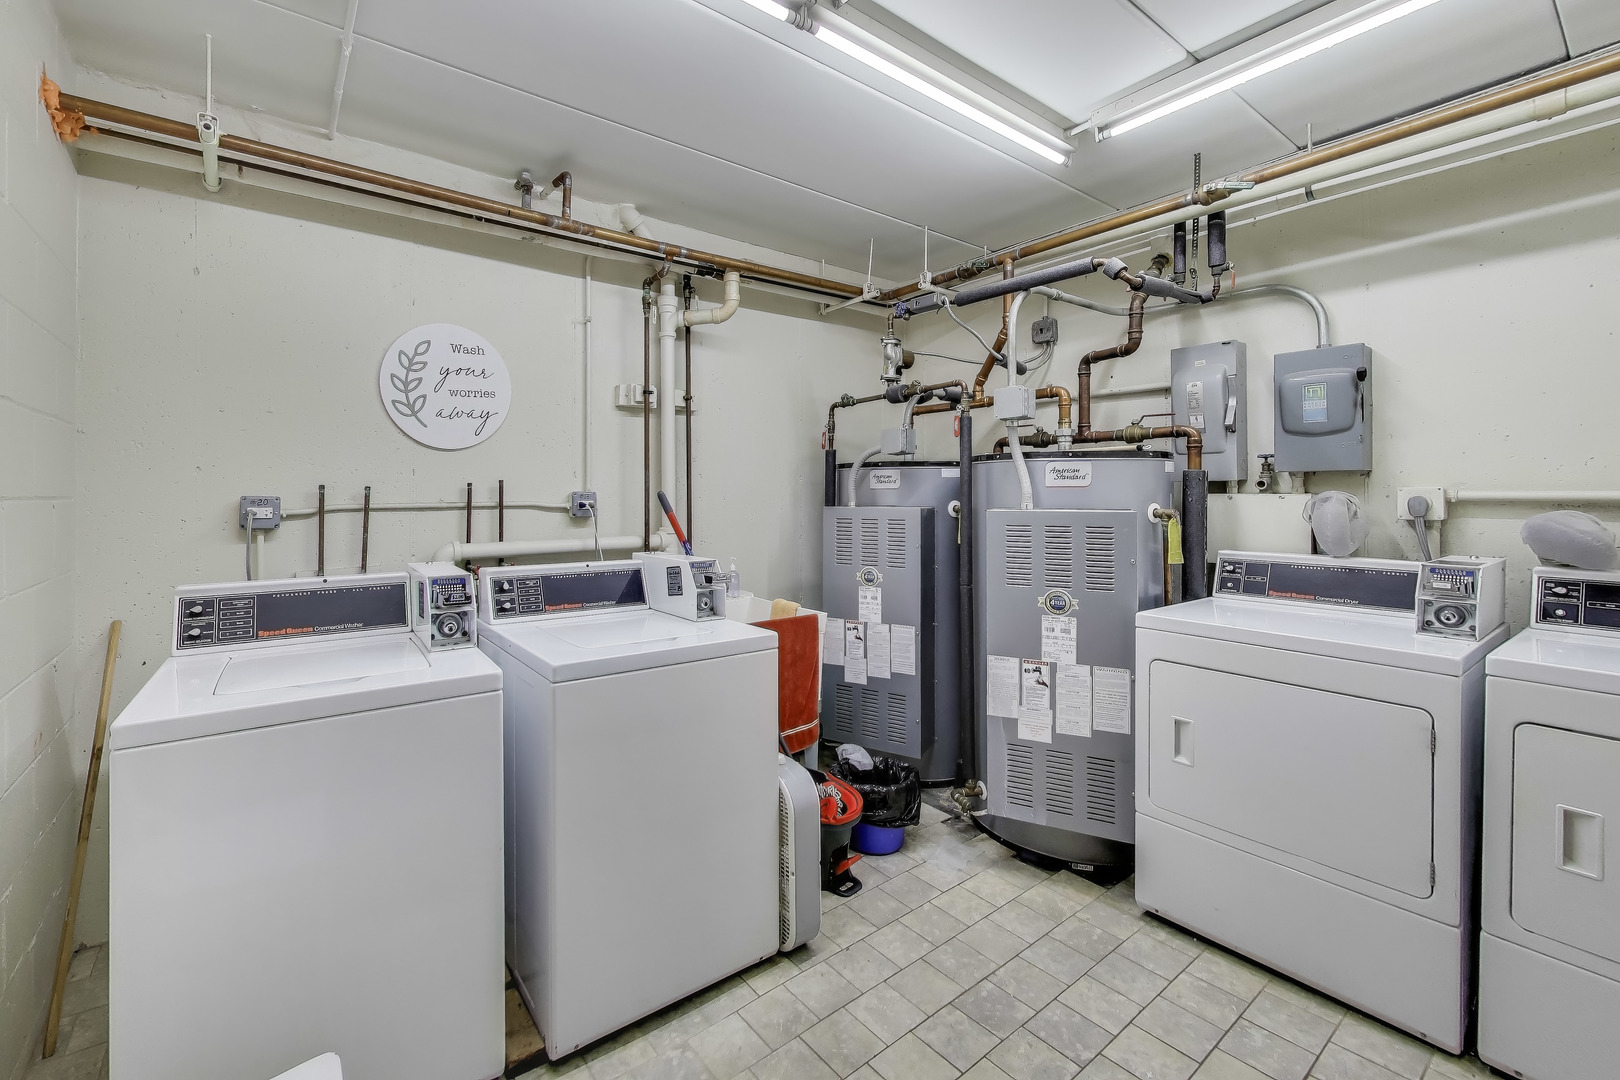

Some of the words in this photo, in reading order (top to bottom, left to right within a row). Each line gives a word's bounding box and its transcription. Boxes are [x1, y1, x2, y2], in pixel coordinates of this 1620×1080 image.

[450, 343, 485, 356] Wash
[434, 366, 495, 393] your
[448, 389, 496, 399] worries
[435, 407, 499, 436] away
[1049, 466, 1080, 475] American
[1344, 597, 1359, 605] Dryer
[258, 628, 286, 638] Speed
[286, 626, 314, 635] Queen
[314, 623, 344, 632] Commercial
[344, 621, 364, 629] Washer
